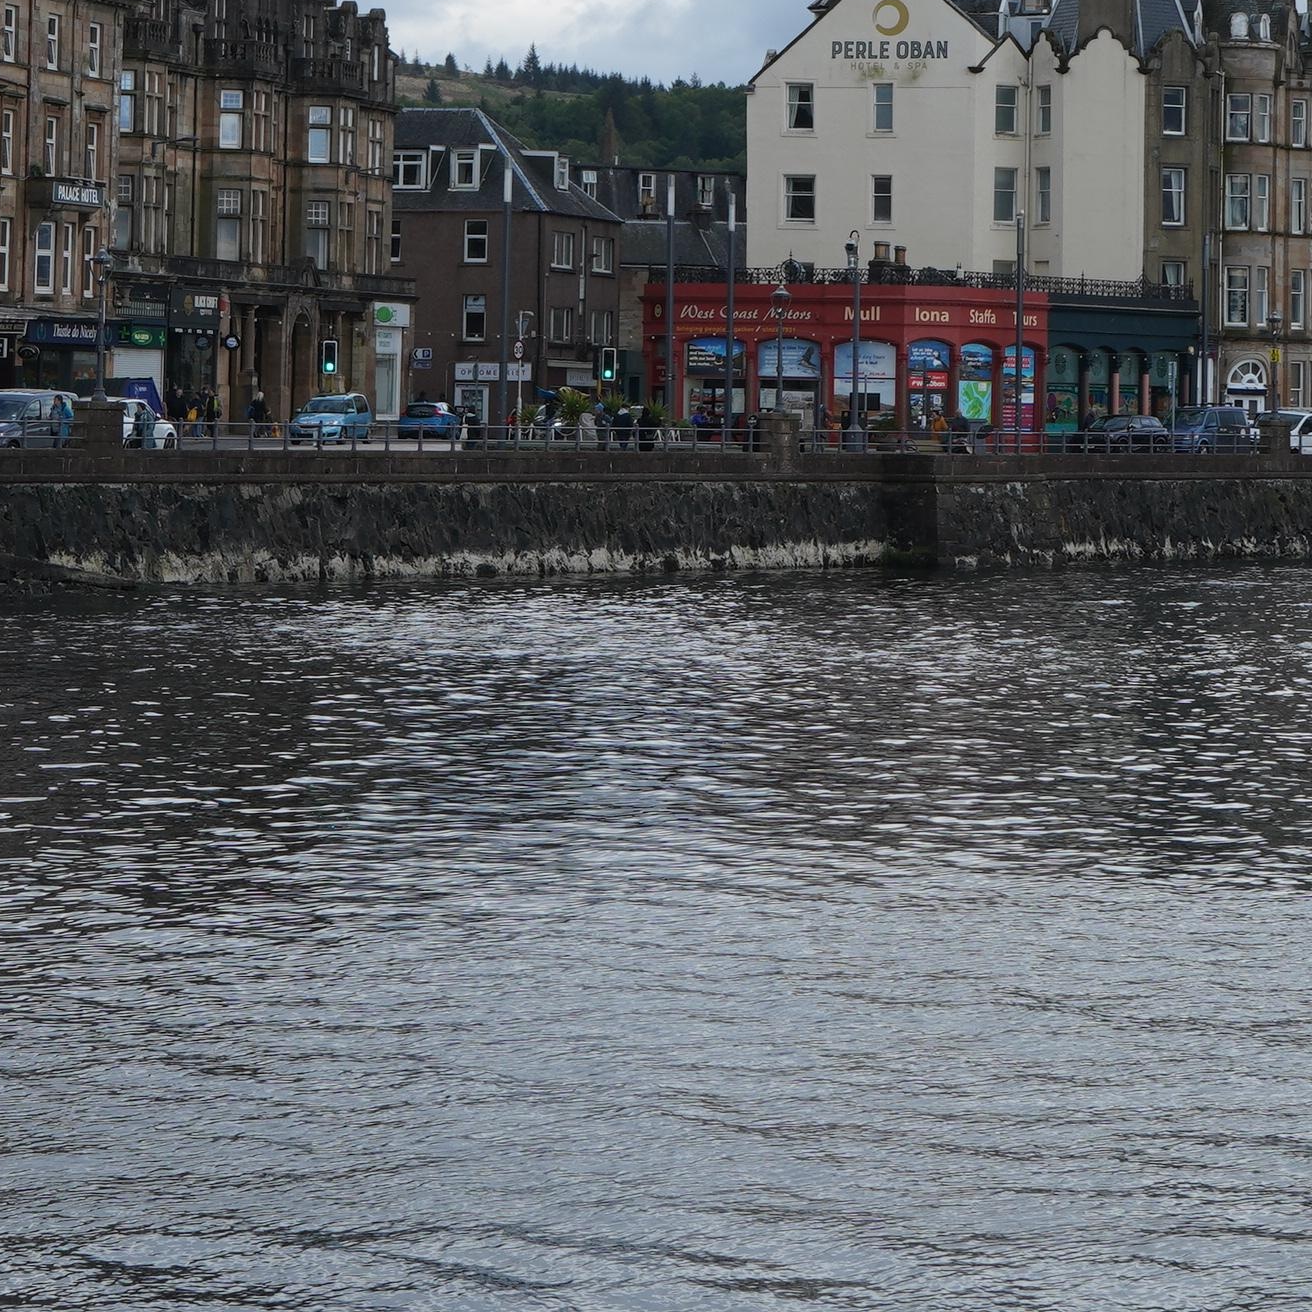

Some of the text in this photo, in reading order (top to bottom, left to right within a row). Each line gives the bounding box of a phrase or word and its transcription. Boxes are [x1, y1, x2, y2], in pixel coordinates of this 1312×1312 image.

[831, 41, 948, 59] PERLE OBAN
[850, 61, 928, 70] HOTEL & SPA
[58, 185, 99, 203] PALACE HOTEL
[680, 305, 714, 319] West
[720, 306, 758, 319] Coast
[844, 306, 1037, 326] Mull Iona Staffa Turs
[515, 345, 523, 355] 30
